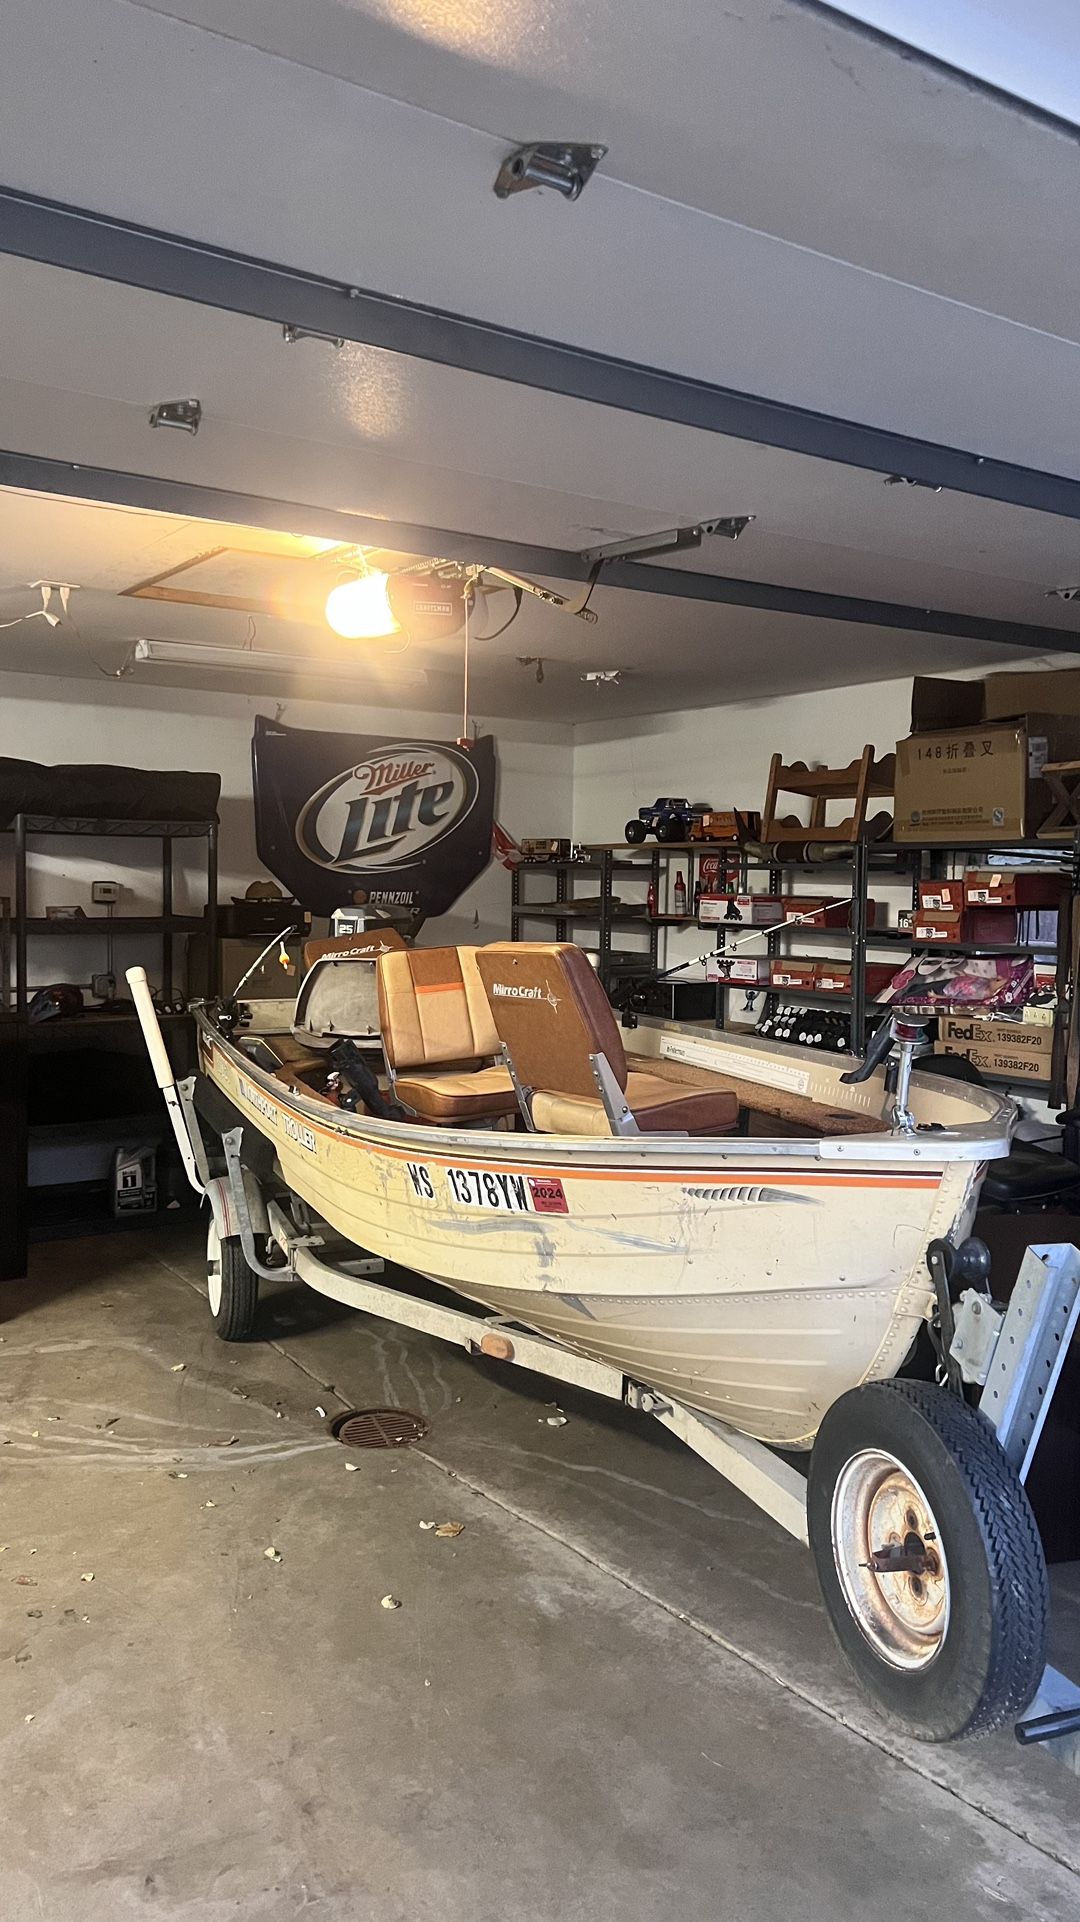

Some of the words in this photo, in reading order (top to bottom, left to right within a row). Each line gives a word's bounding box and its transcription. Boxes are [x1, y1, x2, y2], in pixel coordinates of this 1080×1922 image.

[354, 761, 435, 791] Miller
[331, 780, 455, 864] Lite
[369, 891, 414, 905] PENNZOIL
[339, 924, 354, 934] 25
[948, 1021, 993, 1043] FedEx
[997, 1033, 1042, 1046] 139382F20
[994, 1058, 1040, 1072] 139382F20
[281, 1112, 318, 1155] TROLLER
[447, 1168, 529, 1212] 1378YW
[532, 1187, 564, 1199] 2024
